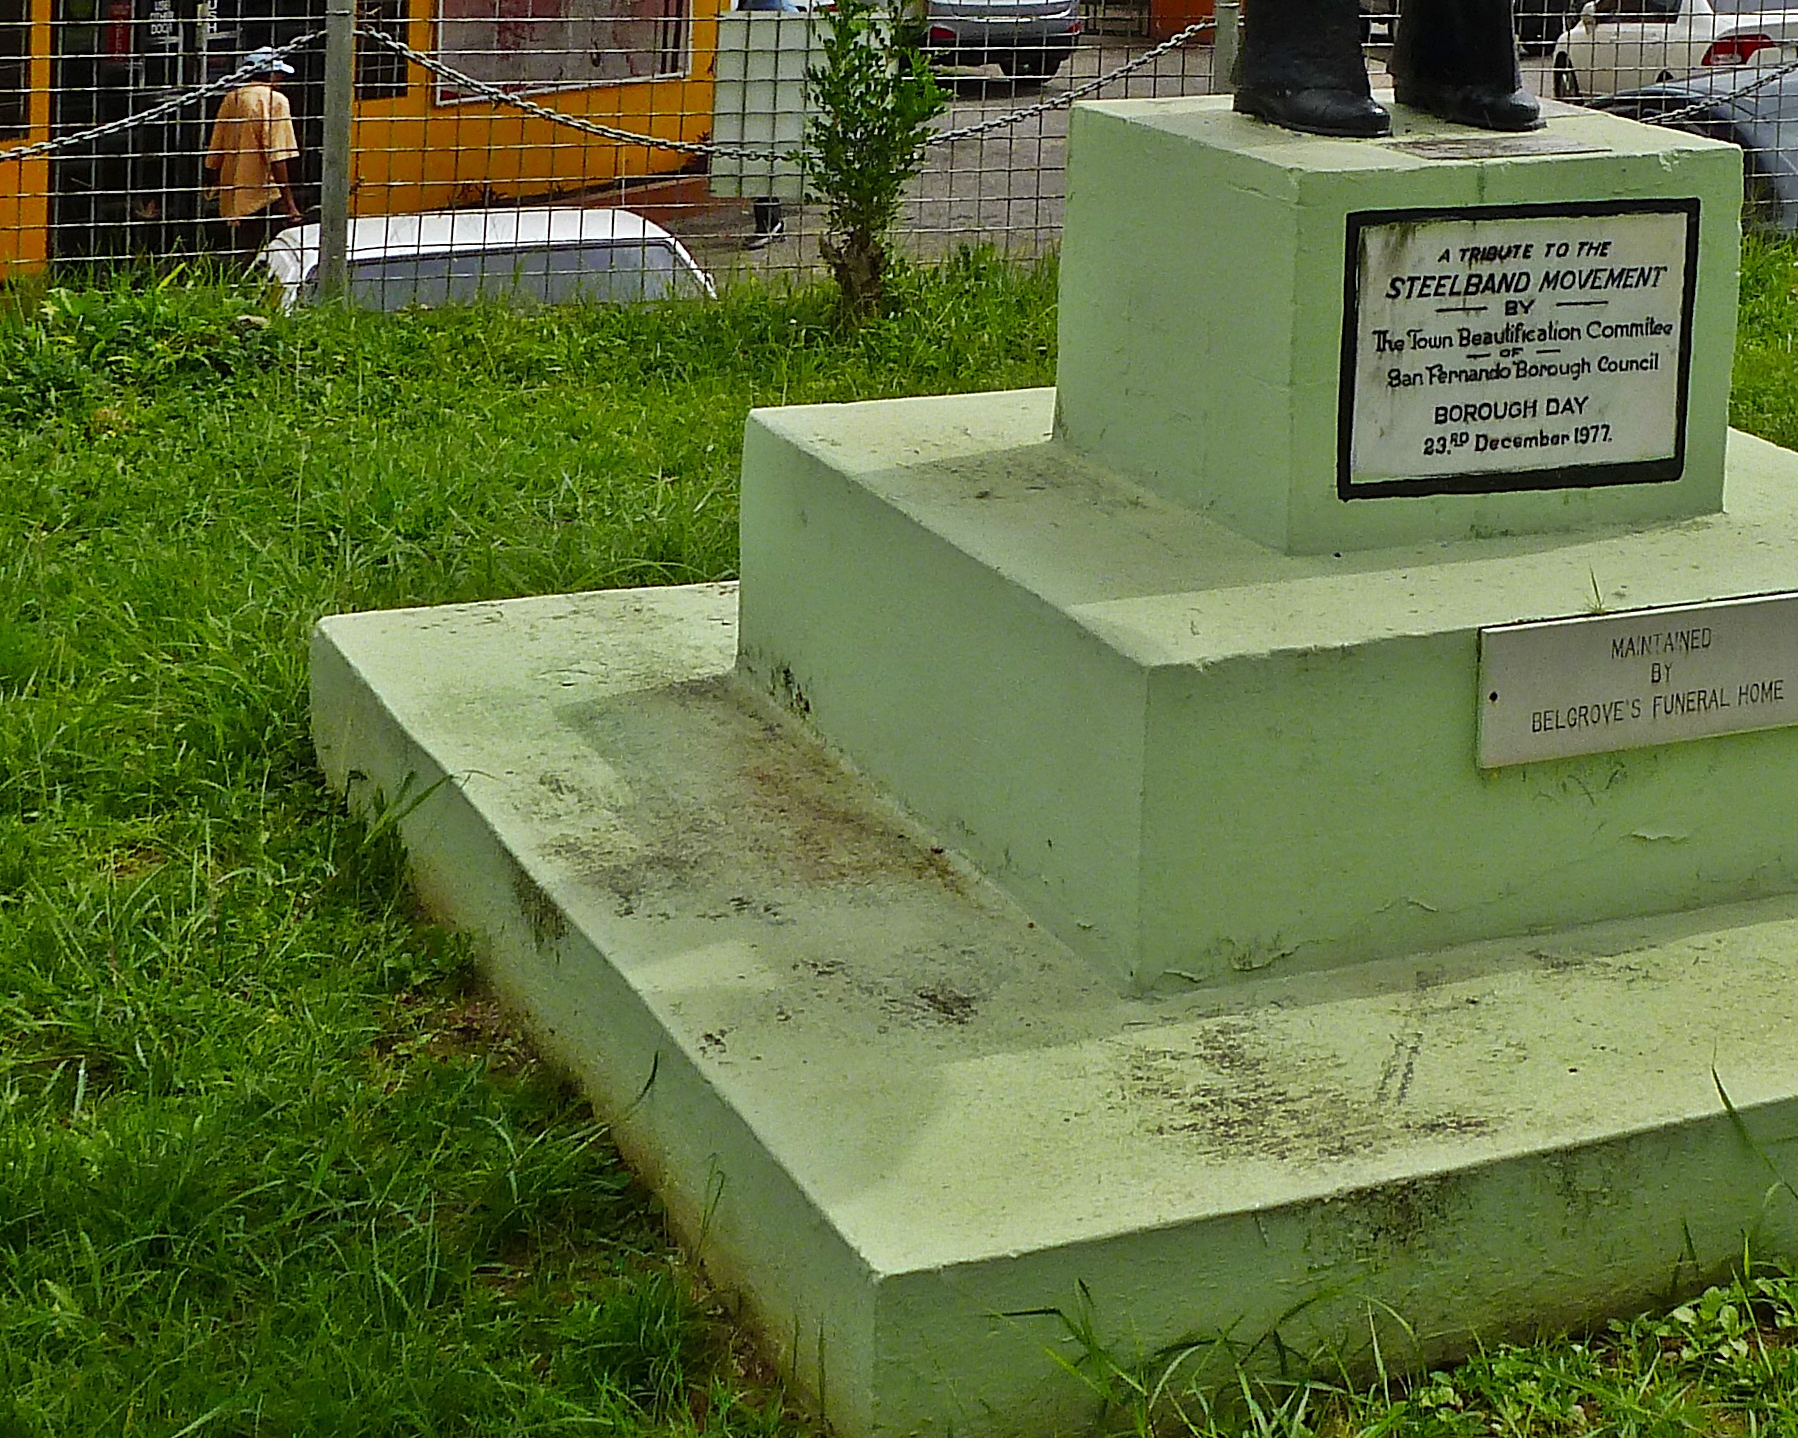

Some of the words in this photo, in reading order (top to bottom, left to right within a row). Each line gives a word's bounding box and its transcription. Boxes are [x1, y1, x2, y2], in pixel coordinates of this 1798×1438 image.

[1437, 248, 1450, 263] A
[1459, 244, 1534, 264] TRIBUTE
[1544, 242, 1569, 258] TO
[1576, 241, 1612, 258] THE
[1386, 272, 1531, 300] STEELBAND
[1538, 266, 1668, 293] MOVEMENT
[1504, 299, 1536, 316] BY
[1372, 329, 1405, 353] The
[1406, 328, 1454, 351] Town
[1457, 320, 1582, 348] Beautification
[1387, 368, 1424, 388] San
[1425, 362, 1512, 386] Fernando
[1512, 358, 1591, 381] Borough
[1597, 353, 1659, 373] Council
[1434, 399, 1538, 425] BOROUGH
[1546, 396, 1589, 417] DAY
[1474, 429, 1570, 452] December
[1611, 627, 1712, 659] MAINTAINED
[1651, 663, 1673, 684] BY
[1532, 698, 1641, 733] BELGROVE'S
[1653, 688, 1730, 719] FUNERAL
[1738, 679, 1785, 706] HOME
